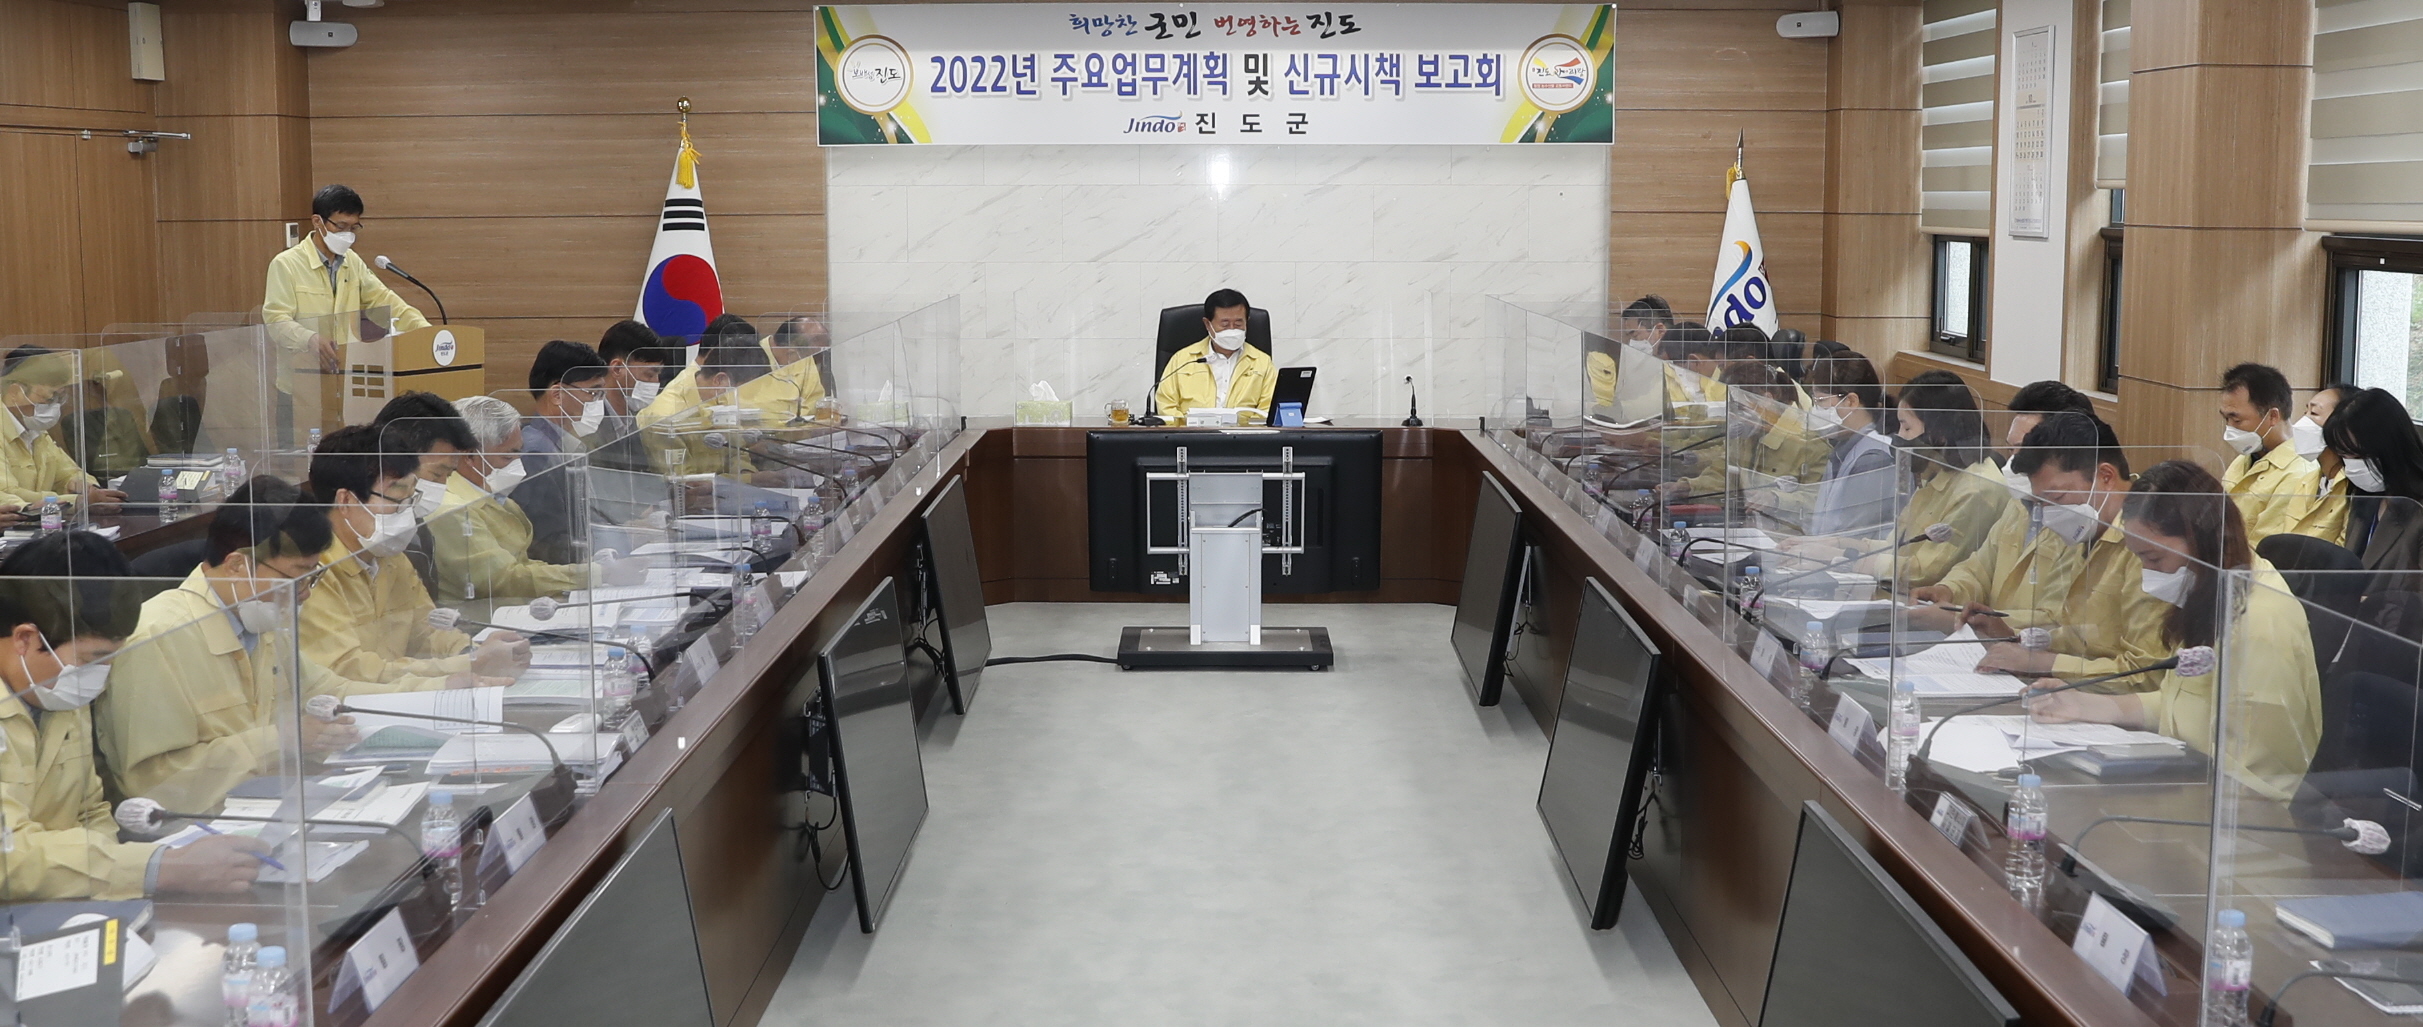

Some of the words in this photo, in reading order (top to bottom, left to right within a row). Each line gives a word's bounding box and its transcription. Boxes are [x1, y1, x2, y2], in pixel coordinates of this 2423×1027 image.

[1068, 13, 1138, 38] 희망찬
[1144, 11, 1202, 40] 군민
[1213, 14, 1302, 38] 번영하는
[1305, 11, 1362, 39] 진도
[930, 53, 1037, 96] 2022년
[1050, 50, 1228, 97] 주요업무계획
[1243, 52, 1269, 96] 및
[1284, 52, 1401, 96] 신규시책
[1414, 52, 1501, 97] 보고회
[1122, 115, 1177, 134] Jindo
